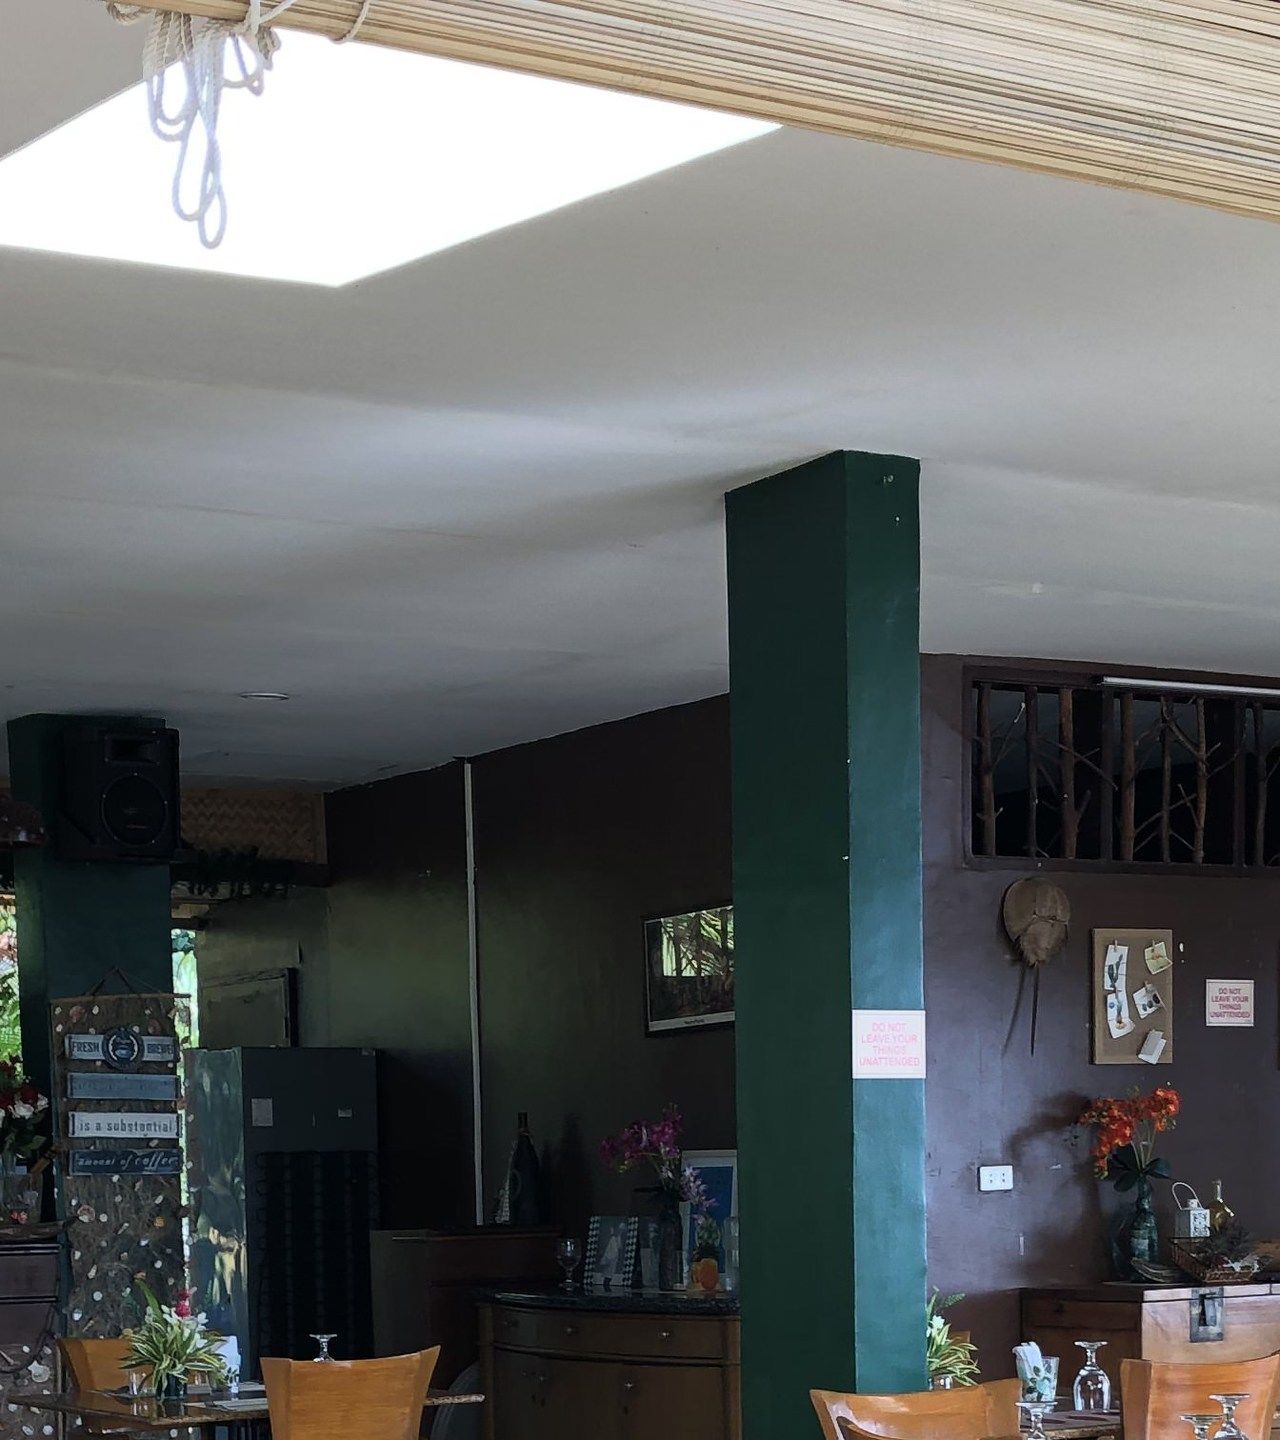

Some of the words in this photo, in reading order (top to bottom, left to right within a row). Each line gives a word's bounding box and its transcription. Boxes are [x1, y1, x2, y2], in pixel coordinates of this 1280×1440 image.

[1219, 987, 1227, 995] DO
[1229, 987, 1241, 995] NOT
[1211, 995, 1230, 1003] LEAVE
[1232, 995, 1249, 1003] YOUR
[872, 1022, 885, 1032] DO
[888, 1022, 907, 1032] NOT
[862, 1033, 891, 1043] LEAVE
[892, 1033, 918, 1043] YOUR
[72, 1042, 100, 1053] FRESH
[872, 1045, 906, 1055] THINGS
[859, 1056, 920, 1066] UNATTENDED
[80, 1120, 90, 1132] is
[95, 1122, 102, 1131] a
[106, 1118, 173, 1132] substantial
[119, 1154, 133, 1170] of
